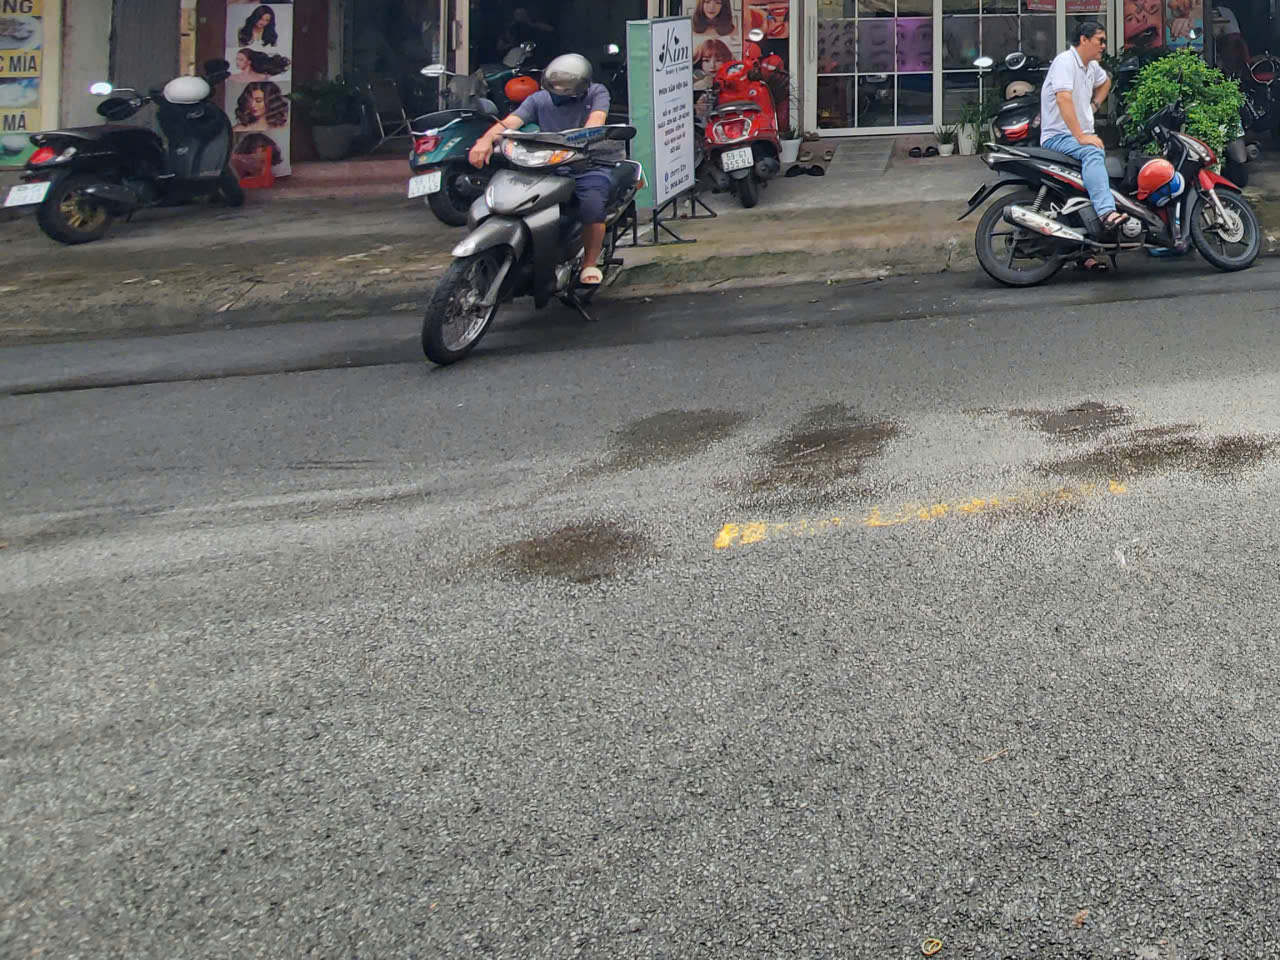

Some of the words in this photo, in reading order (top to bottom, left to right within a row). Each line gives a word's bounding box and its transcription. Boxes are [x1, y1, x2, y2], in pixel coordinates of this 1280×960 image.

[655, 27, 690, 72] Kim
[9, 51, 38, 73] MÍA
[3, 111, 27, 132] MÁ
